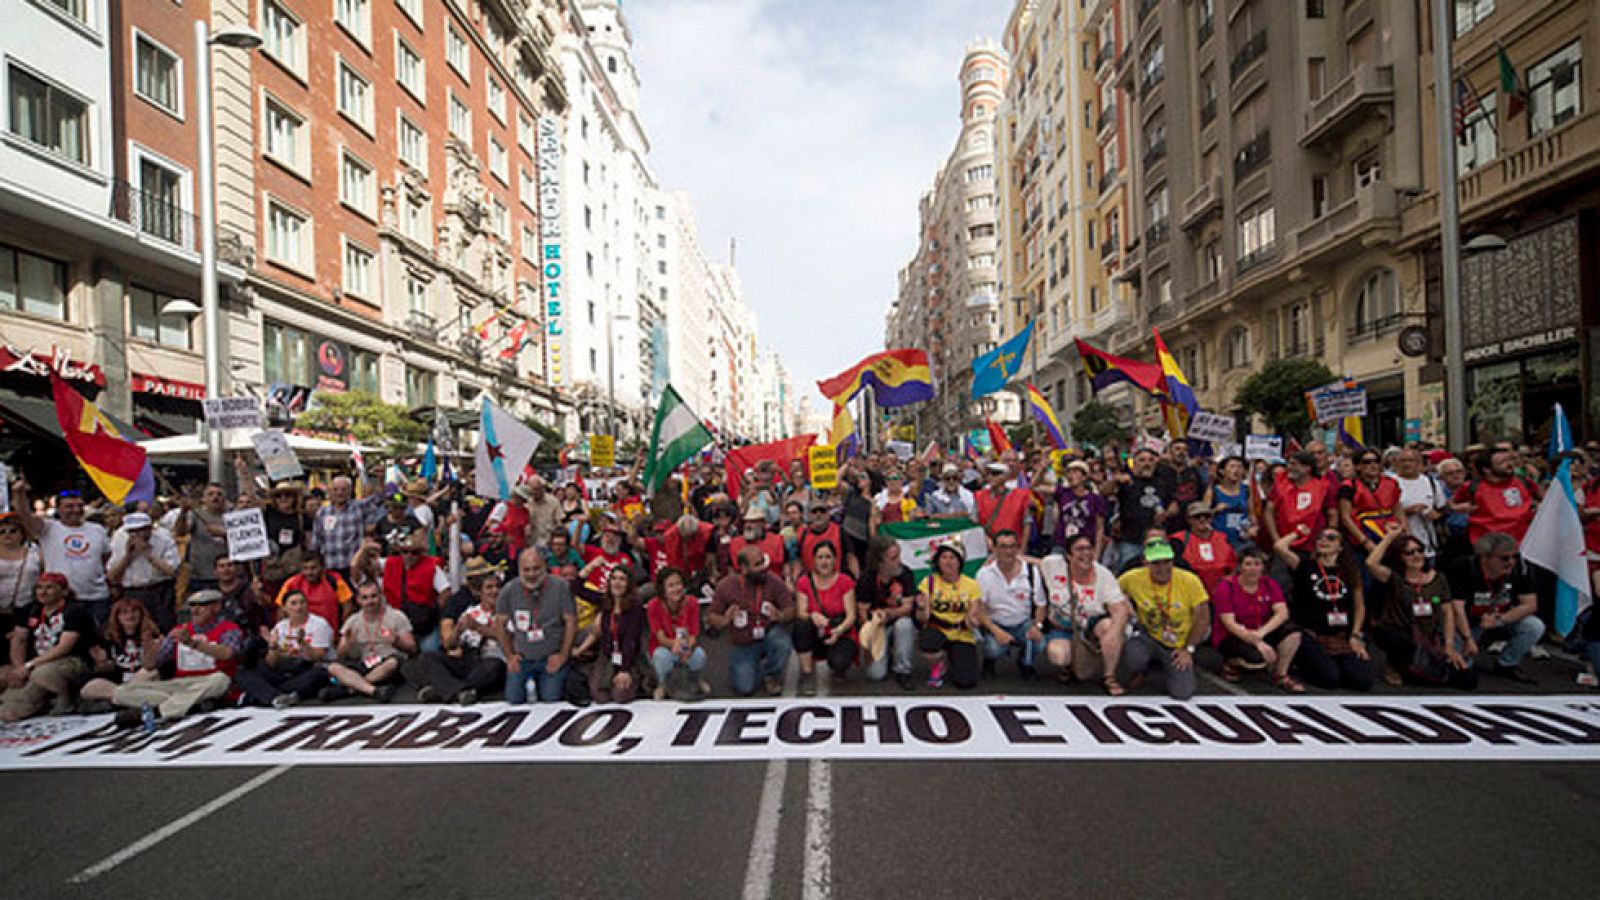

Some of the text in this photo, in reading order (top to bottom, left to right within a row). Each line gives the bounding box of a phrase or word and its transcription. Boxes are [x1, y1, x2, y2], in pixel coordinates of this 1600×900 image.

[544, 244, 563, 335] HOTEL
[226, 708, 643, 755] TRABAJO,
[671, 706, 973, 746] TECHO
[987, 705, 1068, 744] E
